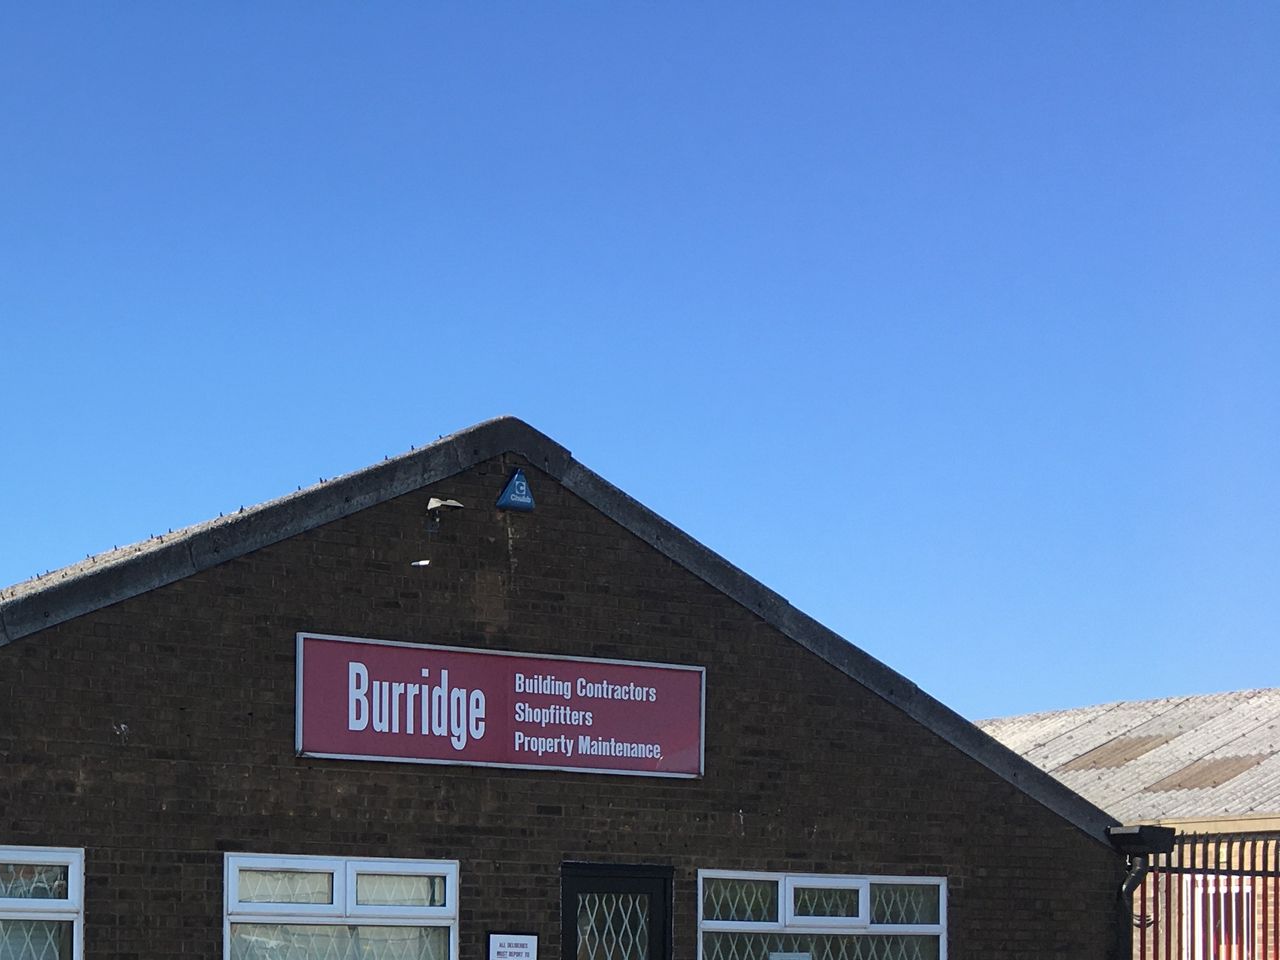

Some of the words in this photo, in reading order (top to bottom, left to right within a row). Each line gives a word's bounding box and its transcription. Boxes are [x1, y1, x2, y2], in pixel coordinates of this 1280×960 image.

[515, 673, 572, 700] Building
[576, 677, 657, 702] Contractors
[347, 661, 486, 751] Burridge
[514, 702, 593, 728] Shopfitters
[514, 731, 574, 757] Property
